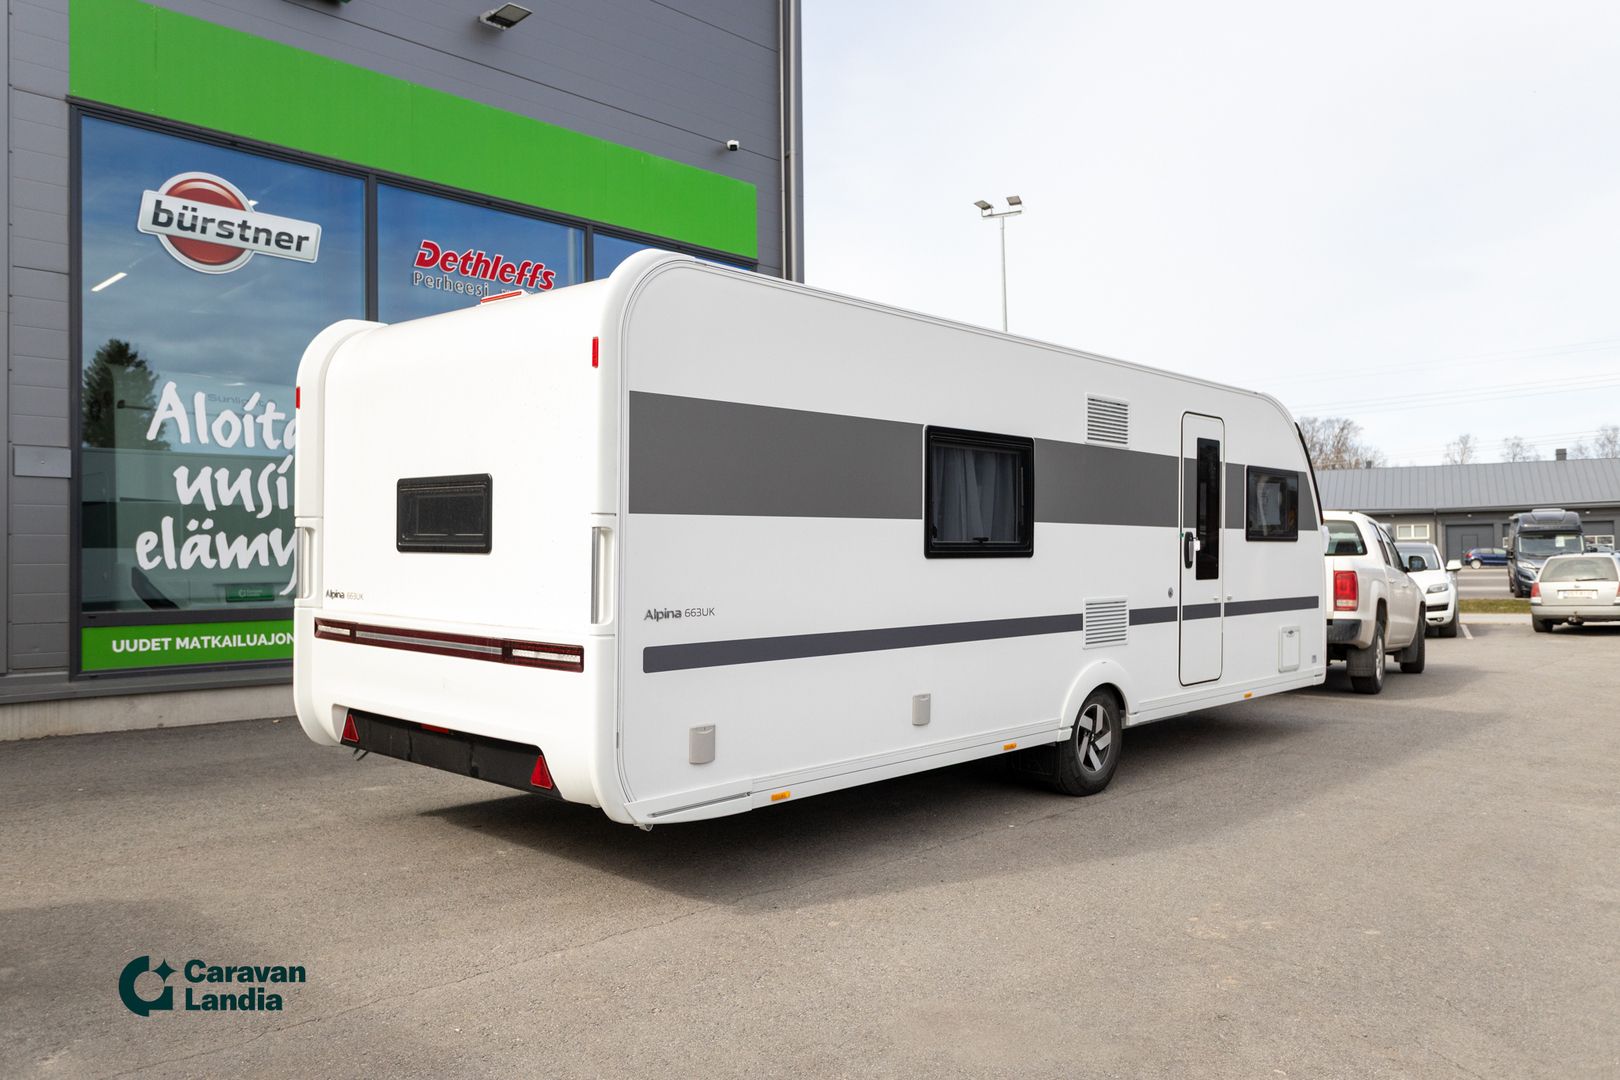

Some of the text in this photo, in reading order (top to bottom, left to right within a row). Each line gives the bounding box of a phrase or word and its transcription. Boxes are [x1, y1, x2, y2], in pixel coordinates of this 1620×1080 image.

[151, 199, 310, 252] bürstner
[414, 239, 556, 291] Dethleffs
[413, 271, 490, 297] Perheesi
[173, 454, 294, 519] uusi
[326, 589, 345, 600] Alpina
[643, 607, 716, 622] Alpina 663UK
[112, 637, 172, 653] UUDET
